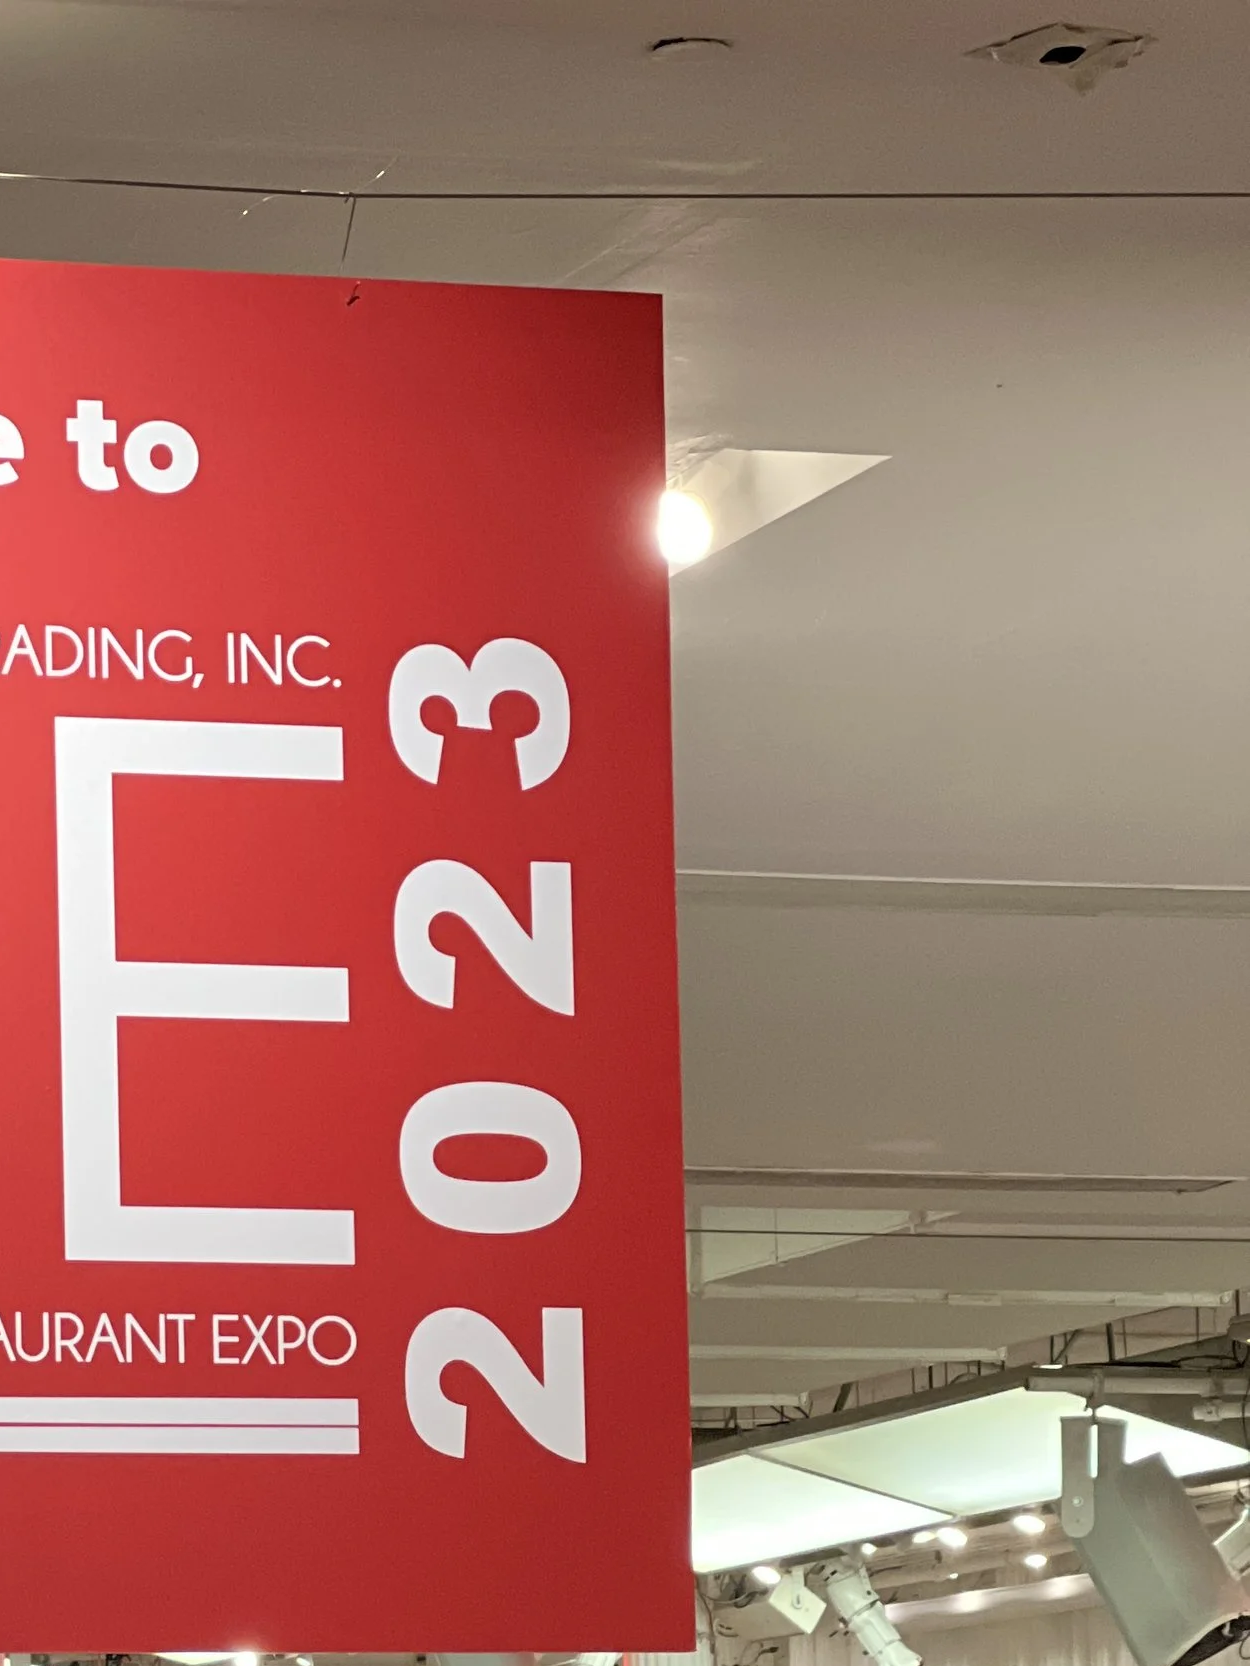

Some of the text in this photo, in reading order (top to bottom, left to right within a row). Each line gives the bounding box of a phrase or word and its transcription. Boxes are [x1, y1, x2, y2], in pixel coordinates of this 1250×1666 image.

[66, 400, 198, 493] to
[227, 633, 341, 688] INC.
[389, 638, 586, 1463] 2023
[213, 1314, 356, 1365] EXPO
